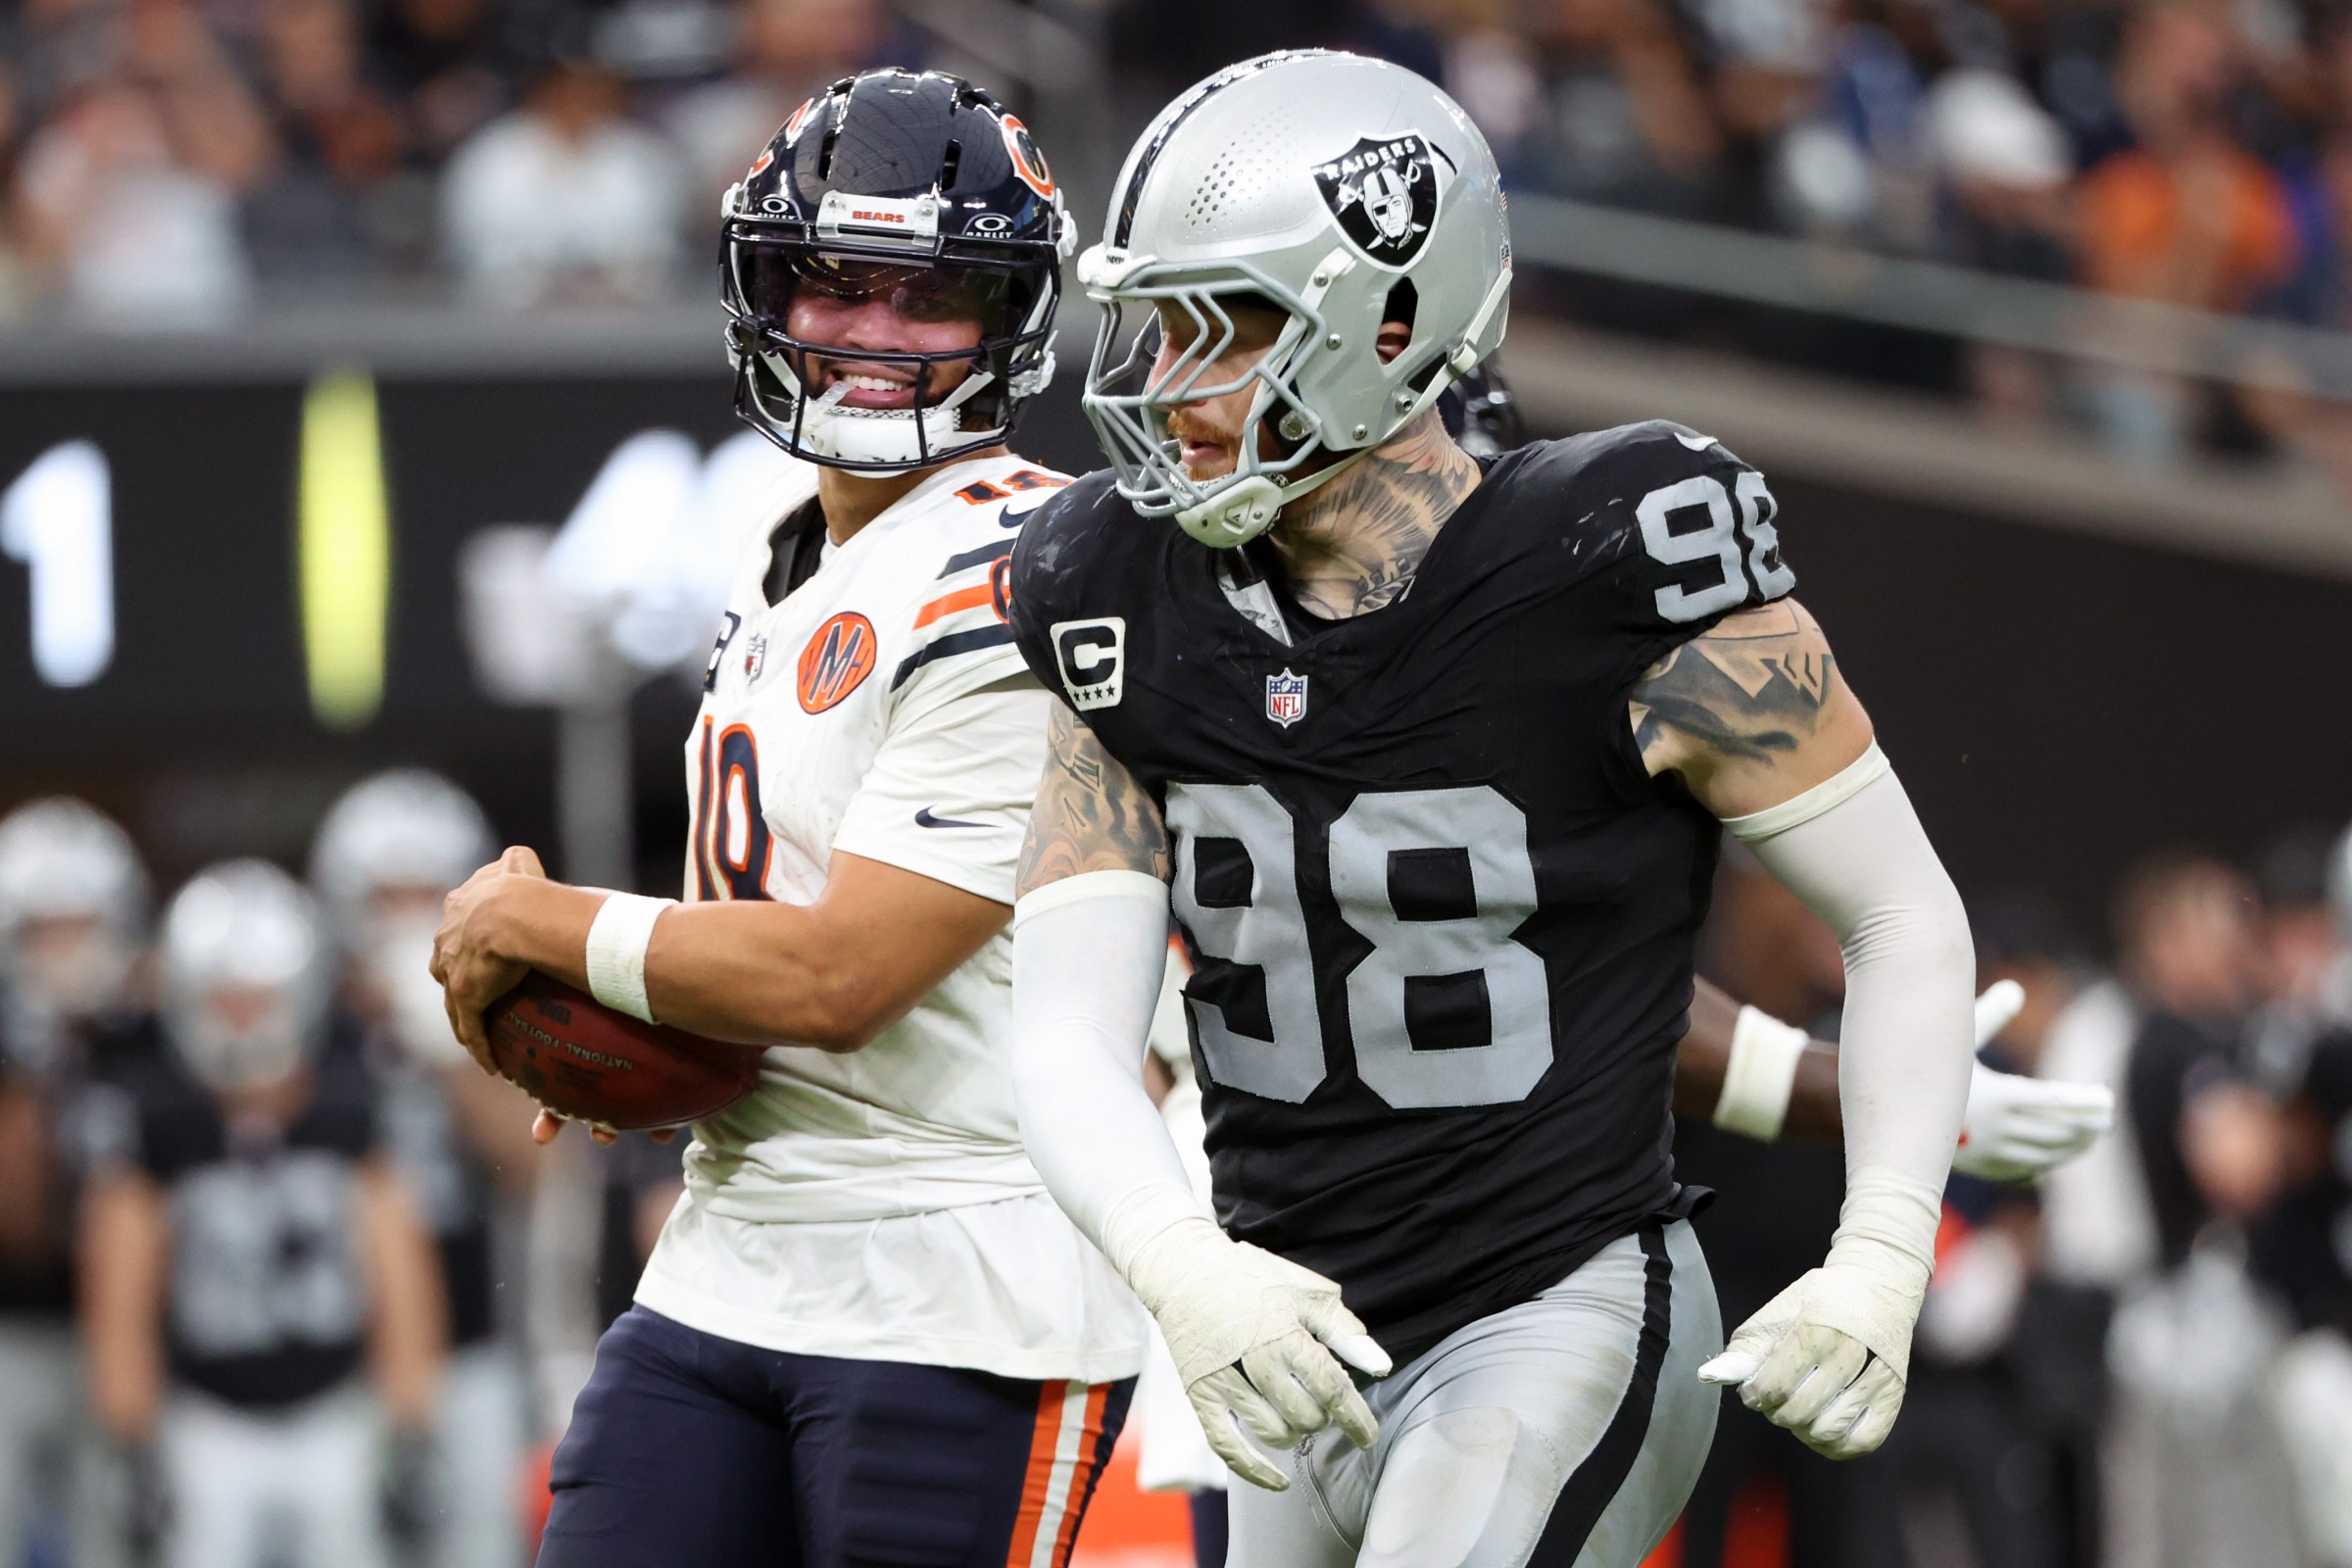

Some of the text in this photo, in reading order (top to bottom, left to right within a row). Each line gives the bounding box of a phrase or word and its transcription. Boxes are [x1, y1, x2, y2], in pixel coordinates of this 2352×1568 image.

[1323, 138, 1416, 180] RAIDERS
[853, 211, 905, 222] BEARS
[1636, 471, 1796, 623] 98
[1059, 625, 1116, 687] C
[1272, 696, 1299, 717] NFL
[1165, 780, 1554, 1108] 98
[504, 1011, 633, 1069] NATIONAL FOOTBAL
